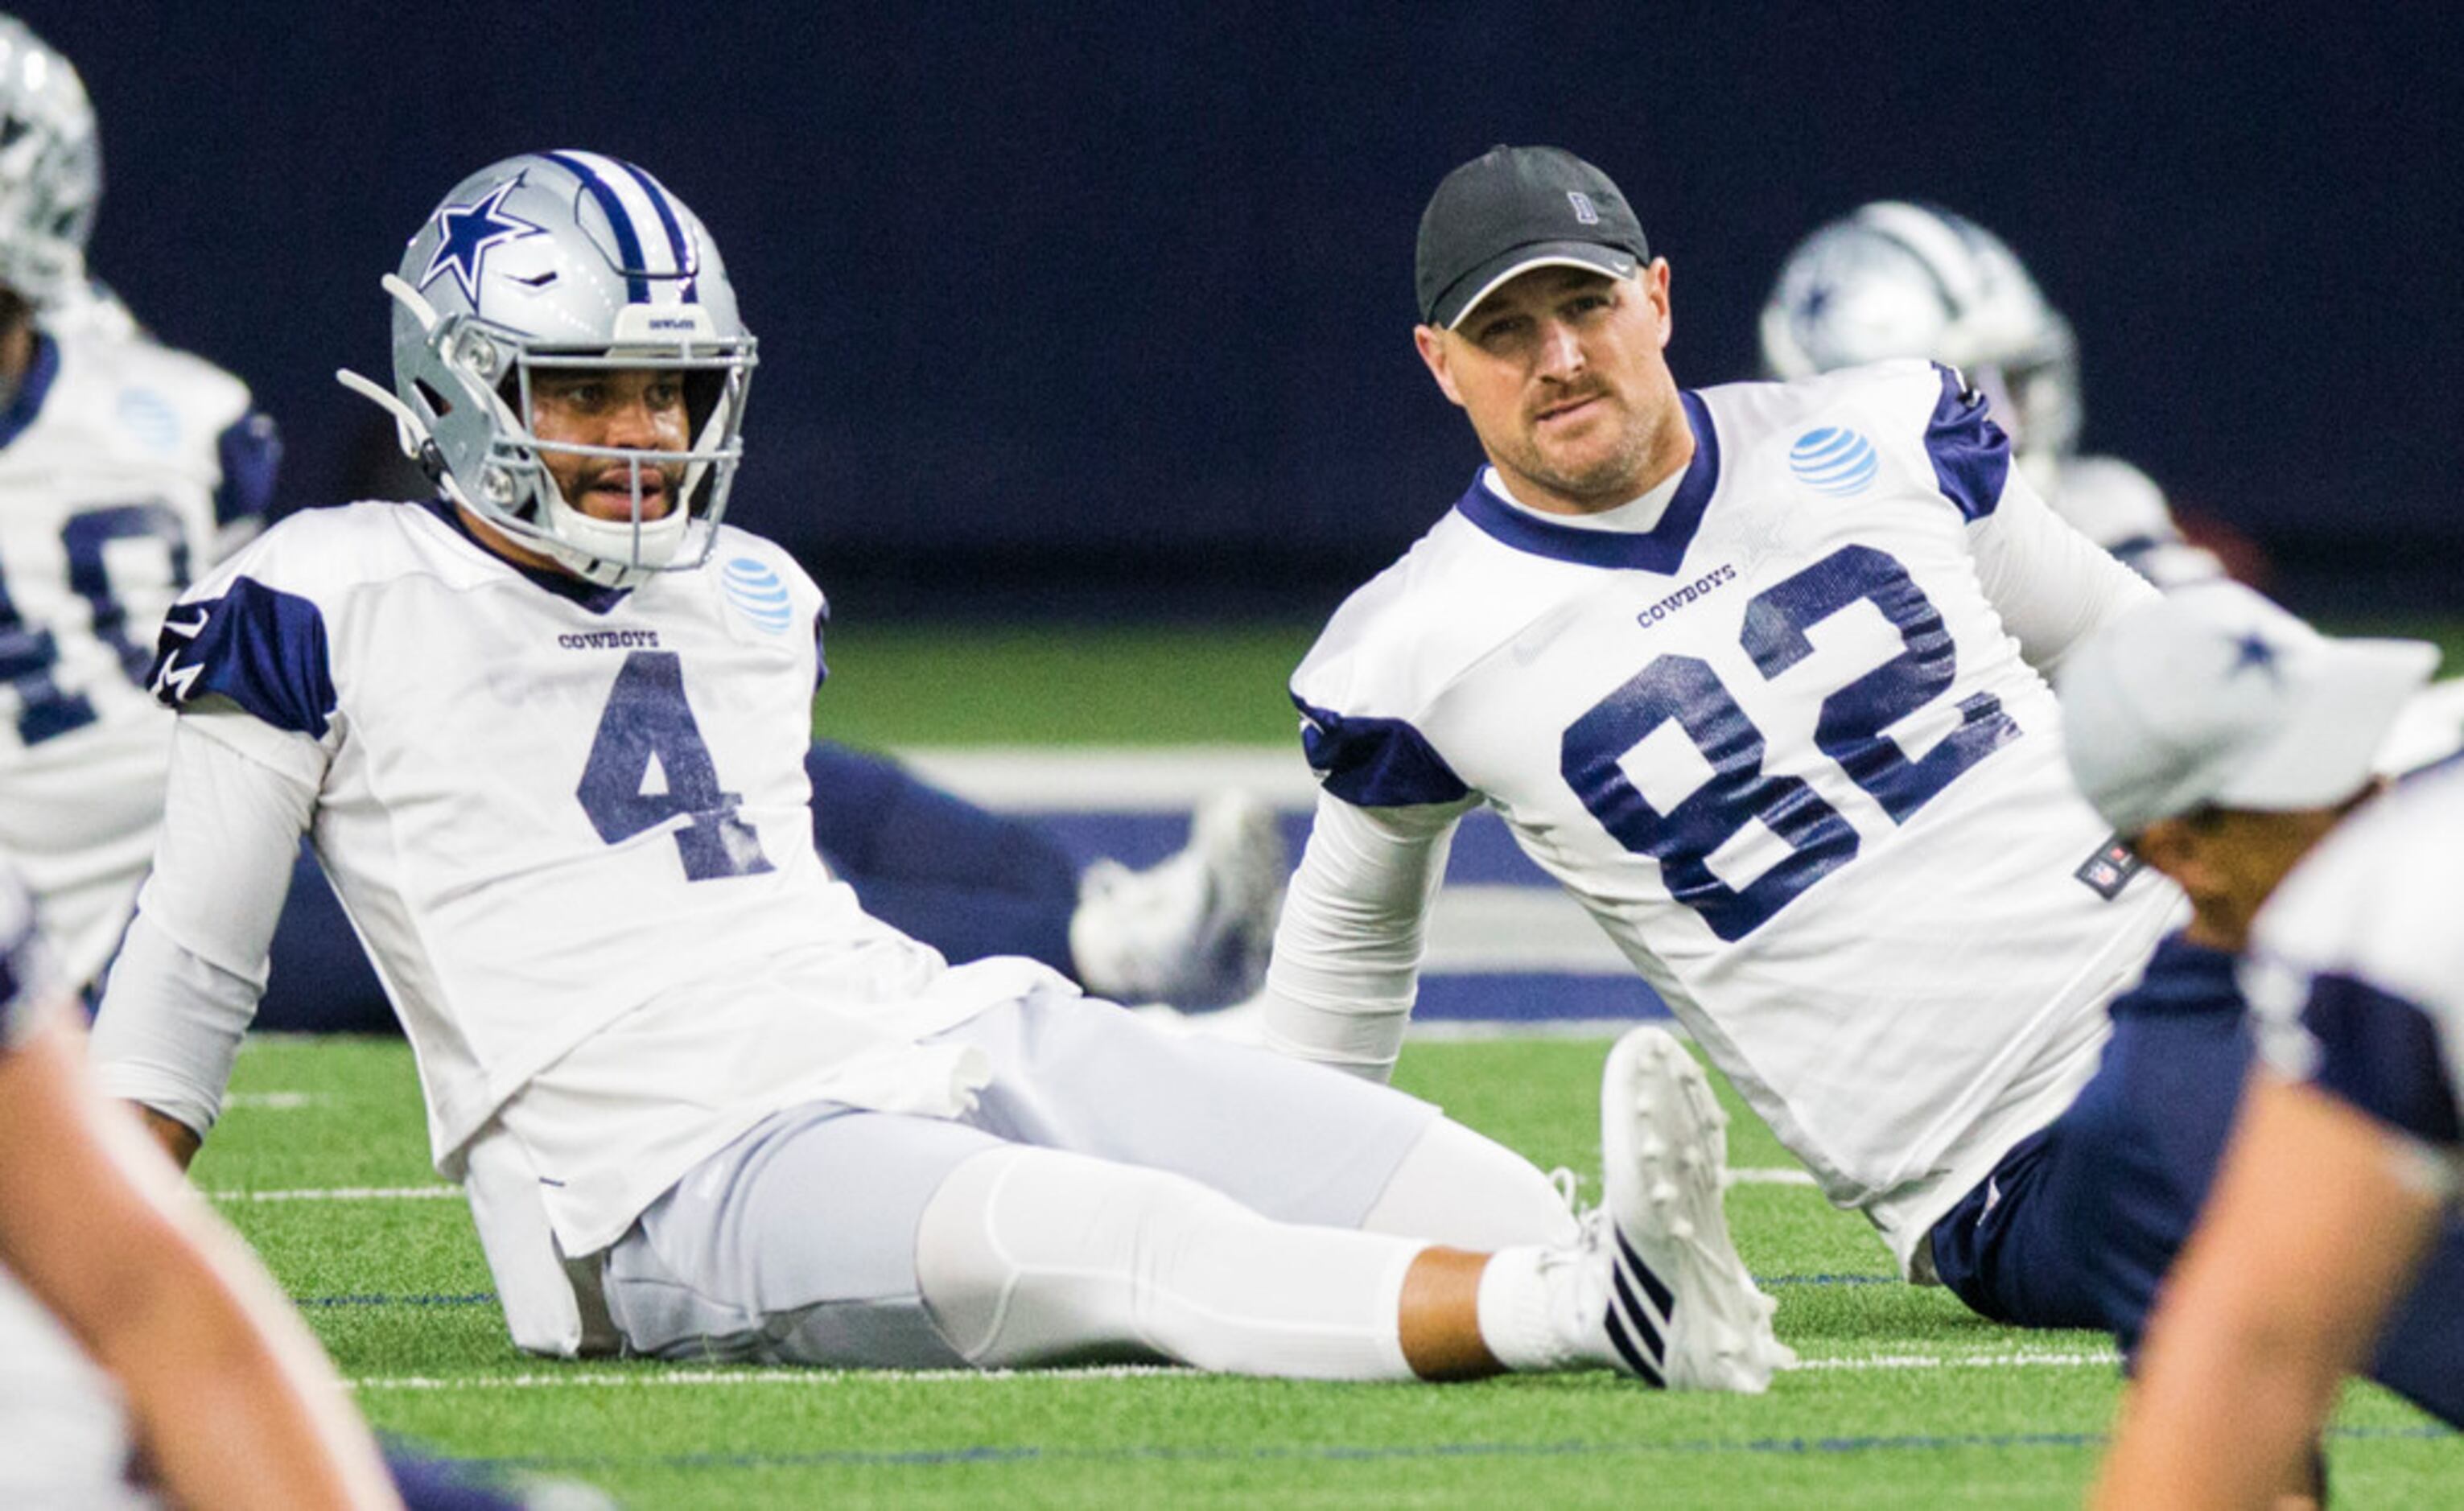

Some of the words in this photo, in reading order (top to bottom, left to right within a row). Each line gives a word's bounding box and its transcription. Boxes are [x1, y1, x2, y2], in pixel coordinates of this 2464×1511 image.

[558, 631, 660, 648] COWBOYS
[1637, 563, 1737, 629] COWBOYS
[575, 650, 777, 882] 4
[1560, 543, 2024, 943] 82
